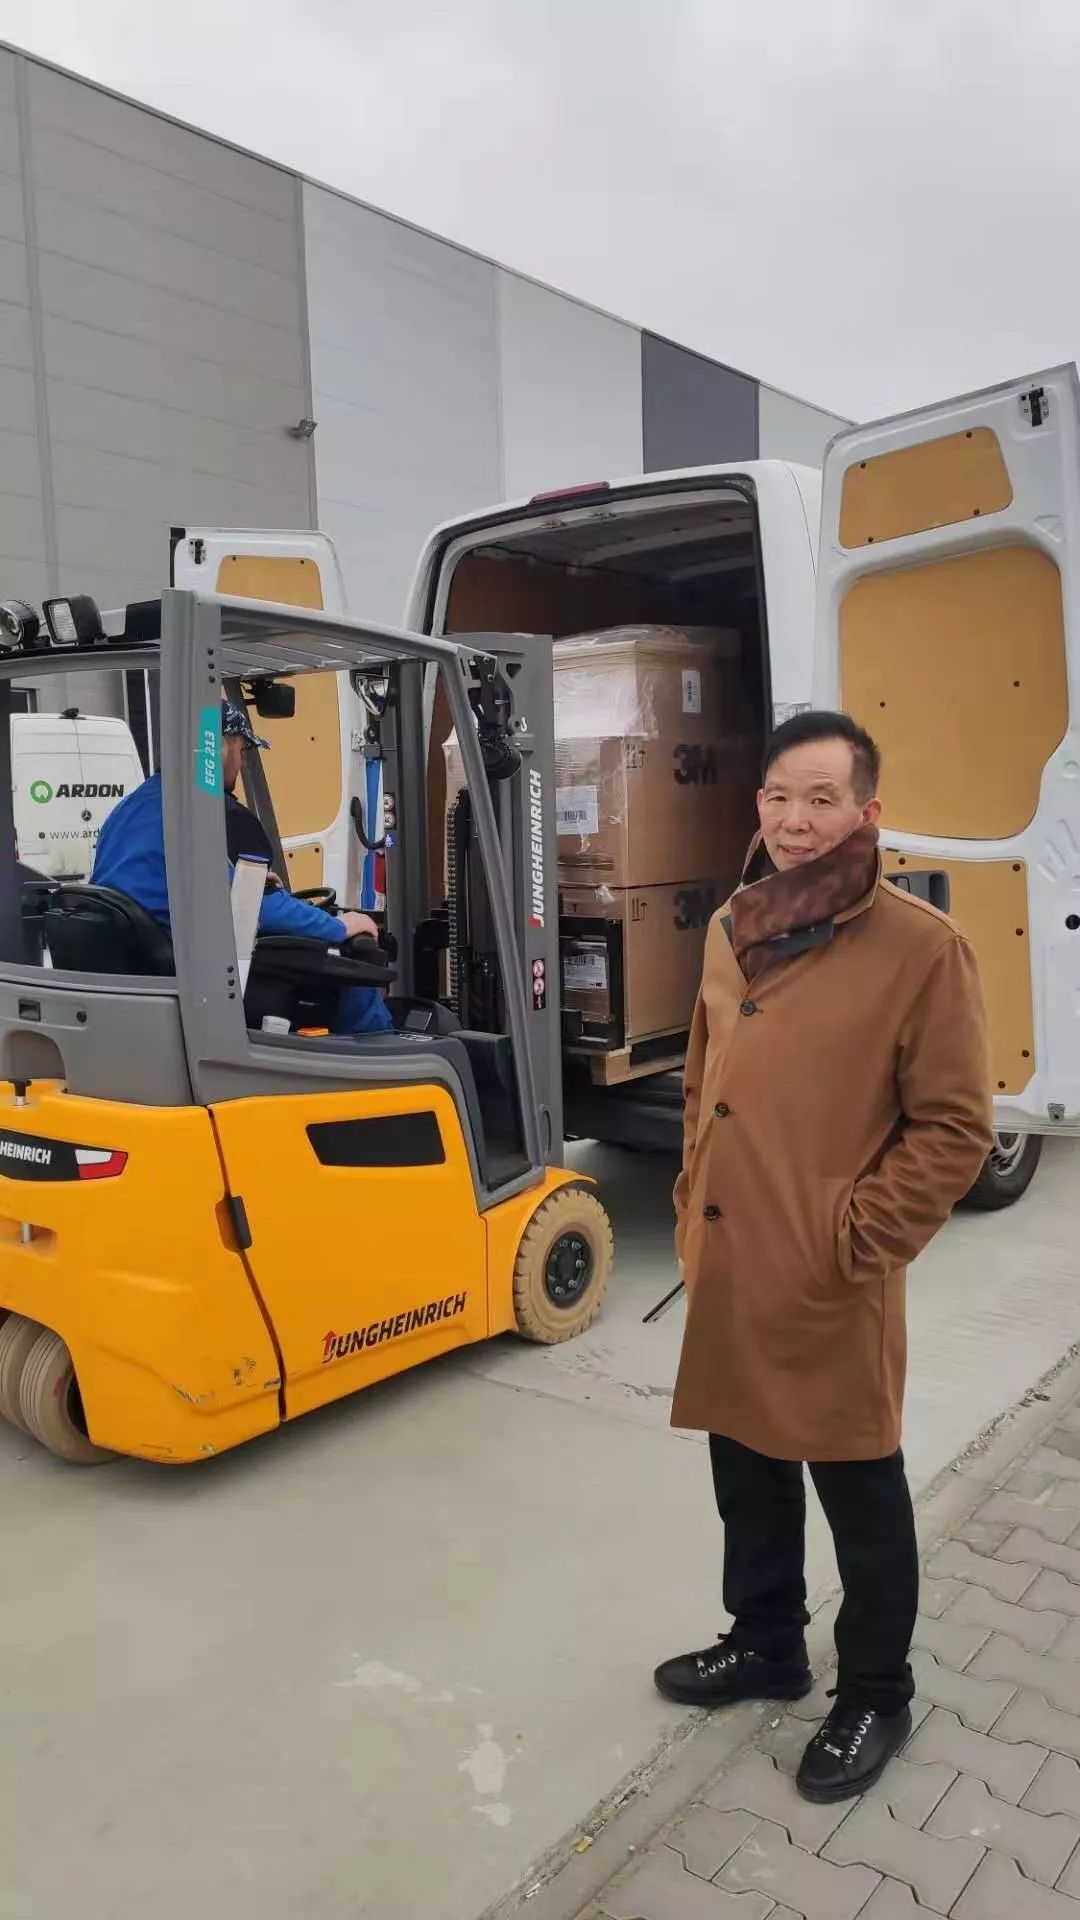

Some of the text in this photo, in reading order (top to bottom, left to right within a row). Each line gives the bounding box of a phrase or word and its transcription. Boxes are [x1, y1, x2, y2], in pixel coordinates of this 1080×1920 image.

[204, 730, 217, 787] EFG 213
[673, 744, 717, 785] 3M
[56, 784, 124, 798] ARDON
[528, 768, 545, 928] JUNGHEINRICH
[321, 1291, 468, 1365] JUNGHEINRICH
